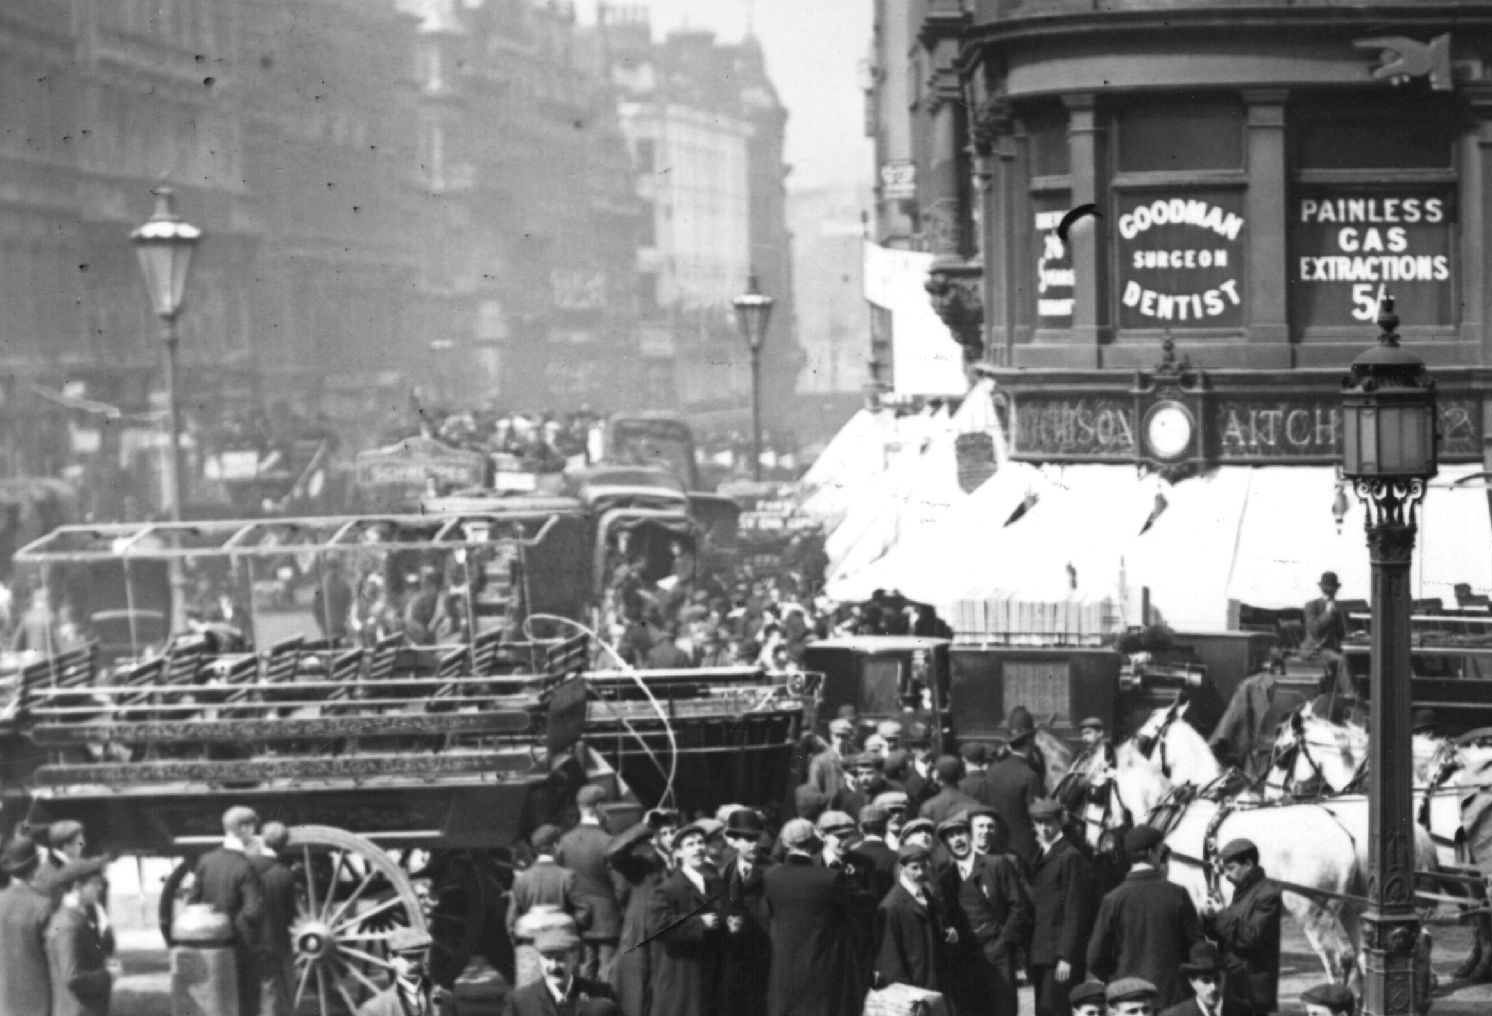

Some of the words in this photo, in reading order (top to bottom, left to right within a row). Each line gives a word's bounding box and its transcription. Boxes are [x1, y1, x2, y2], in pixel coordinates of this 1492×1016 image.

[1118, 199, 1245, 241] GOODMAN
[1302, 198, 1444, 224] PAINLESS
[1337, 227, 1408, 253] GAS
[1132, 249, 1229, 269] SURGEON
[1300, 255, 1450, 281] EXTRACTIONS
[1122, 279, 1242, 321] DENTIST
